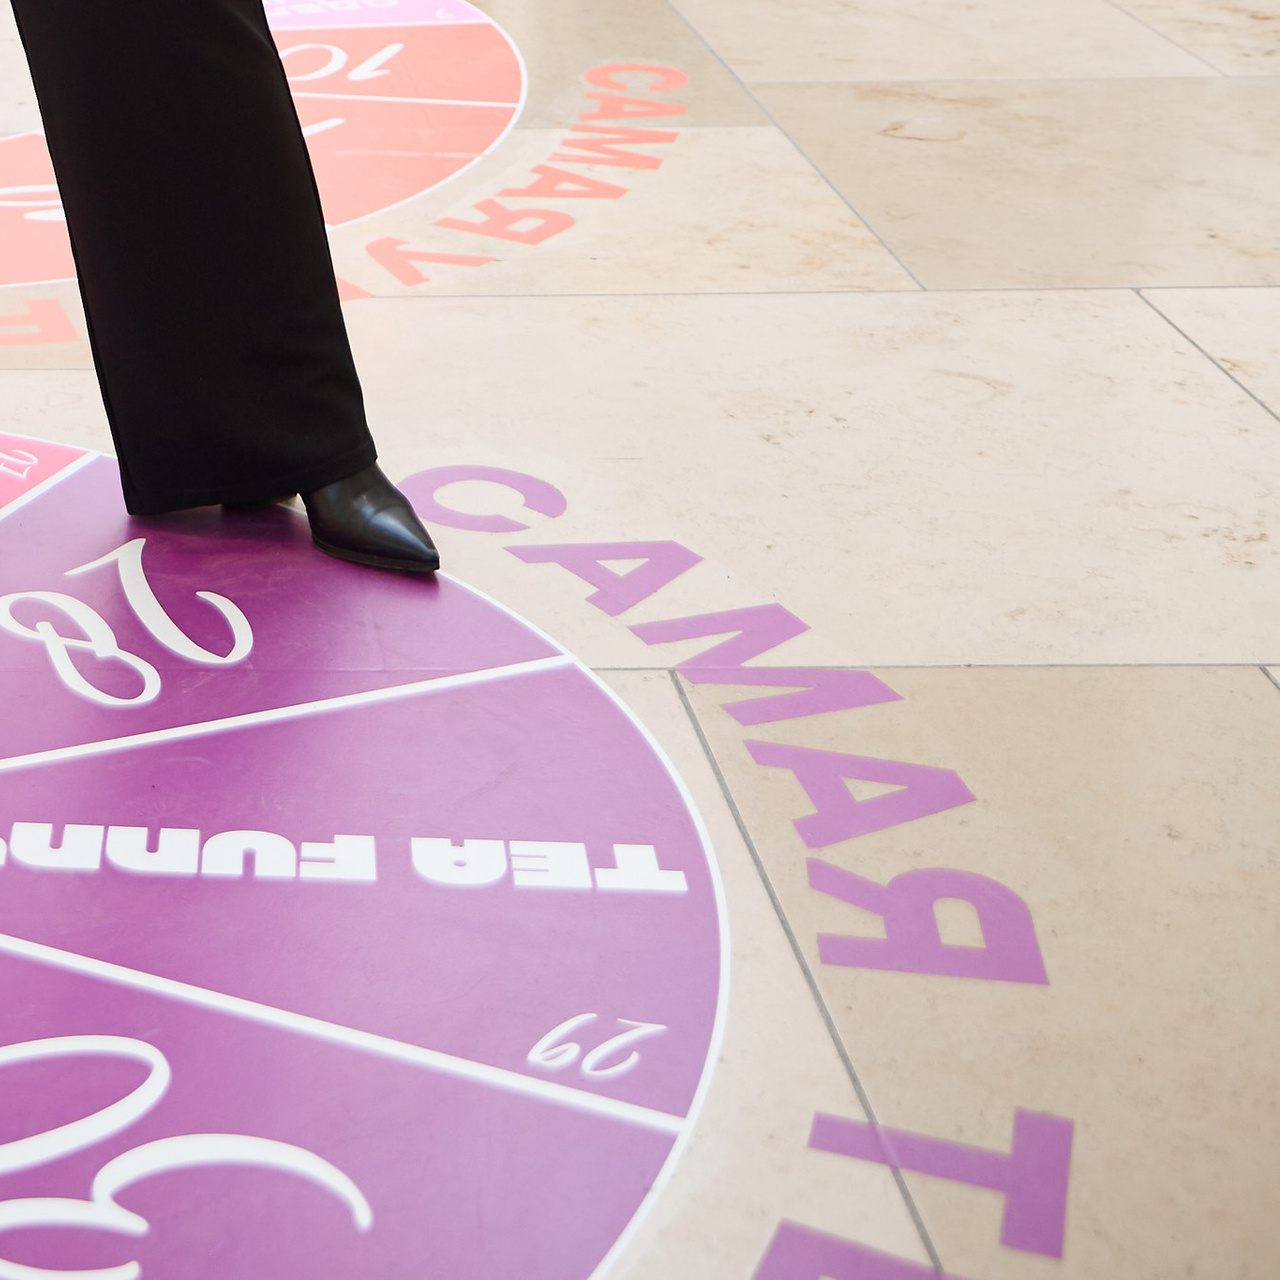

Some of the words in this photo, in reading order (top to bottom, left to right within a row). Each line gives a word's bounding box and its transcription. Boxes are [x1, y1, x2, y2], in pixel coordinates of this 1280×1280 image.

[433, 62, 690, 246] САМАЯ
[393, 464, 1051, 987] САМАЯ
[410, 833, 690, 894] TEA
[526, 1011, 669, 1080] 29
